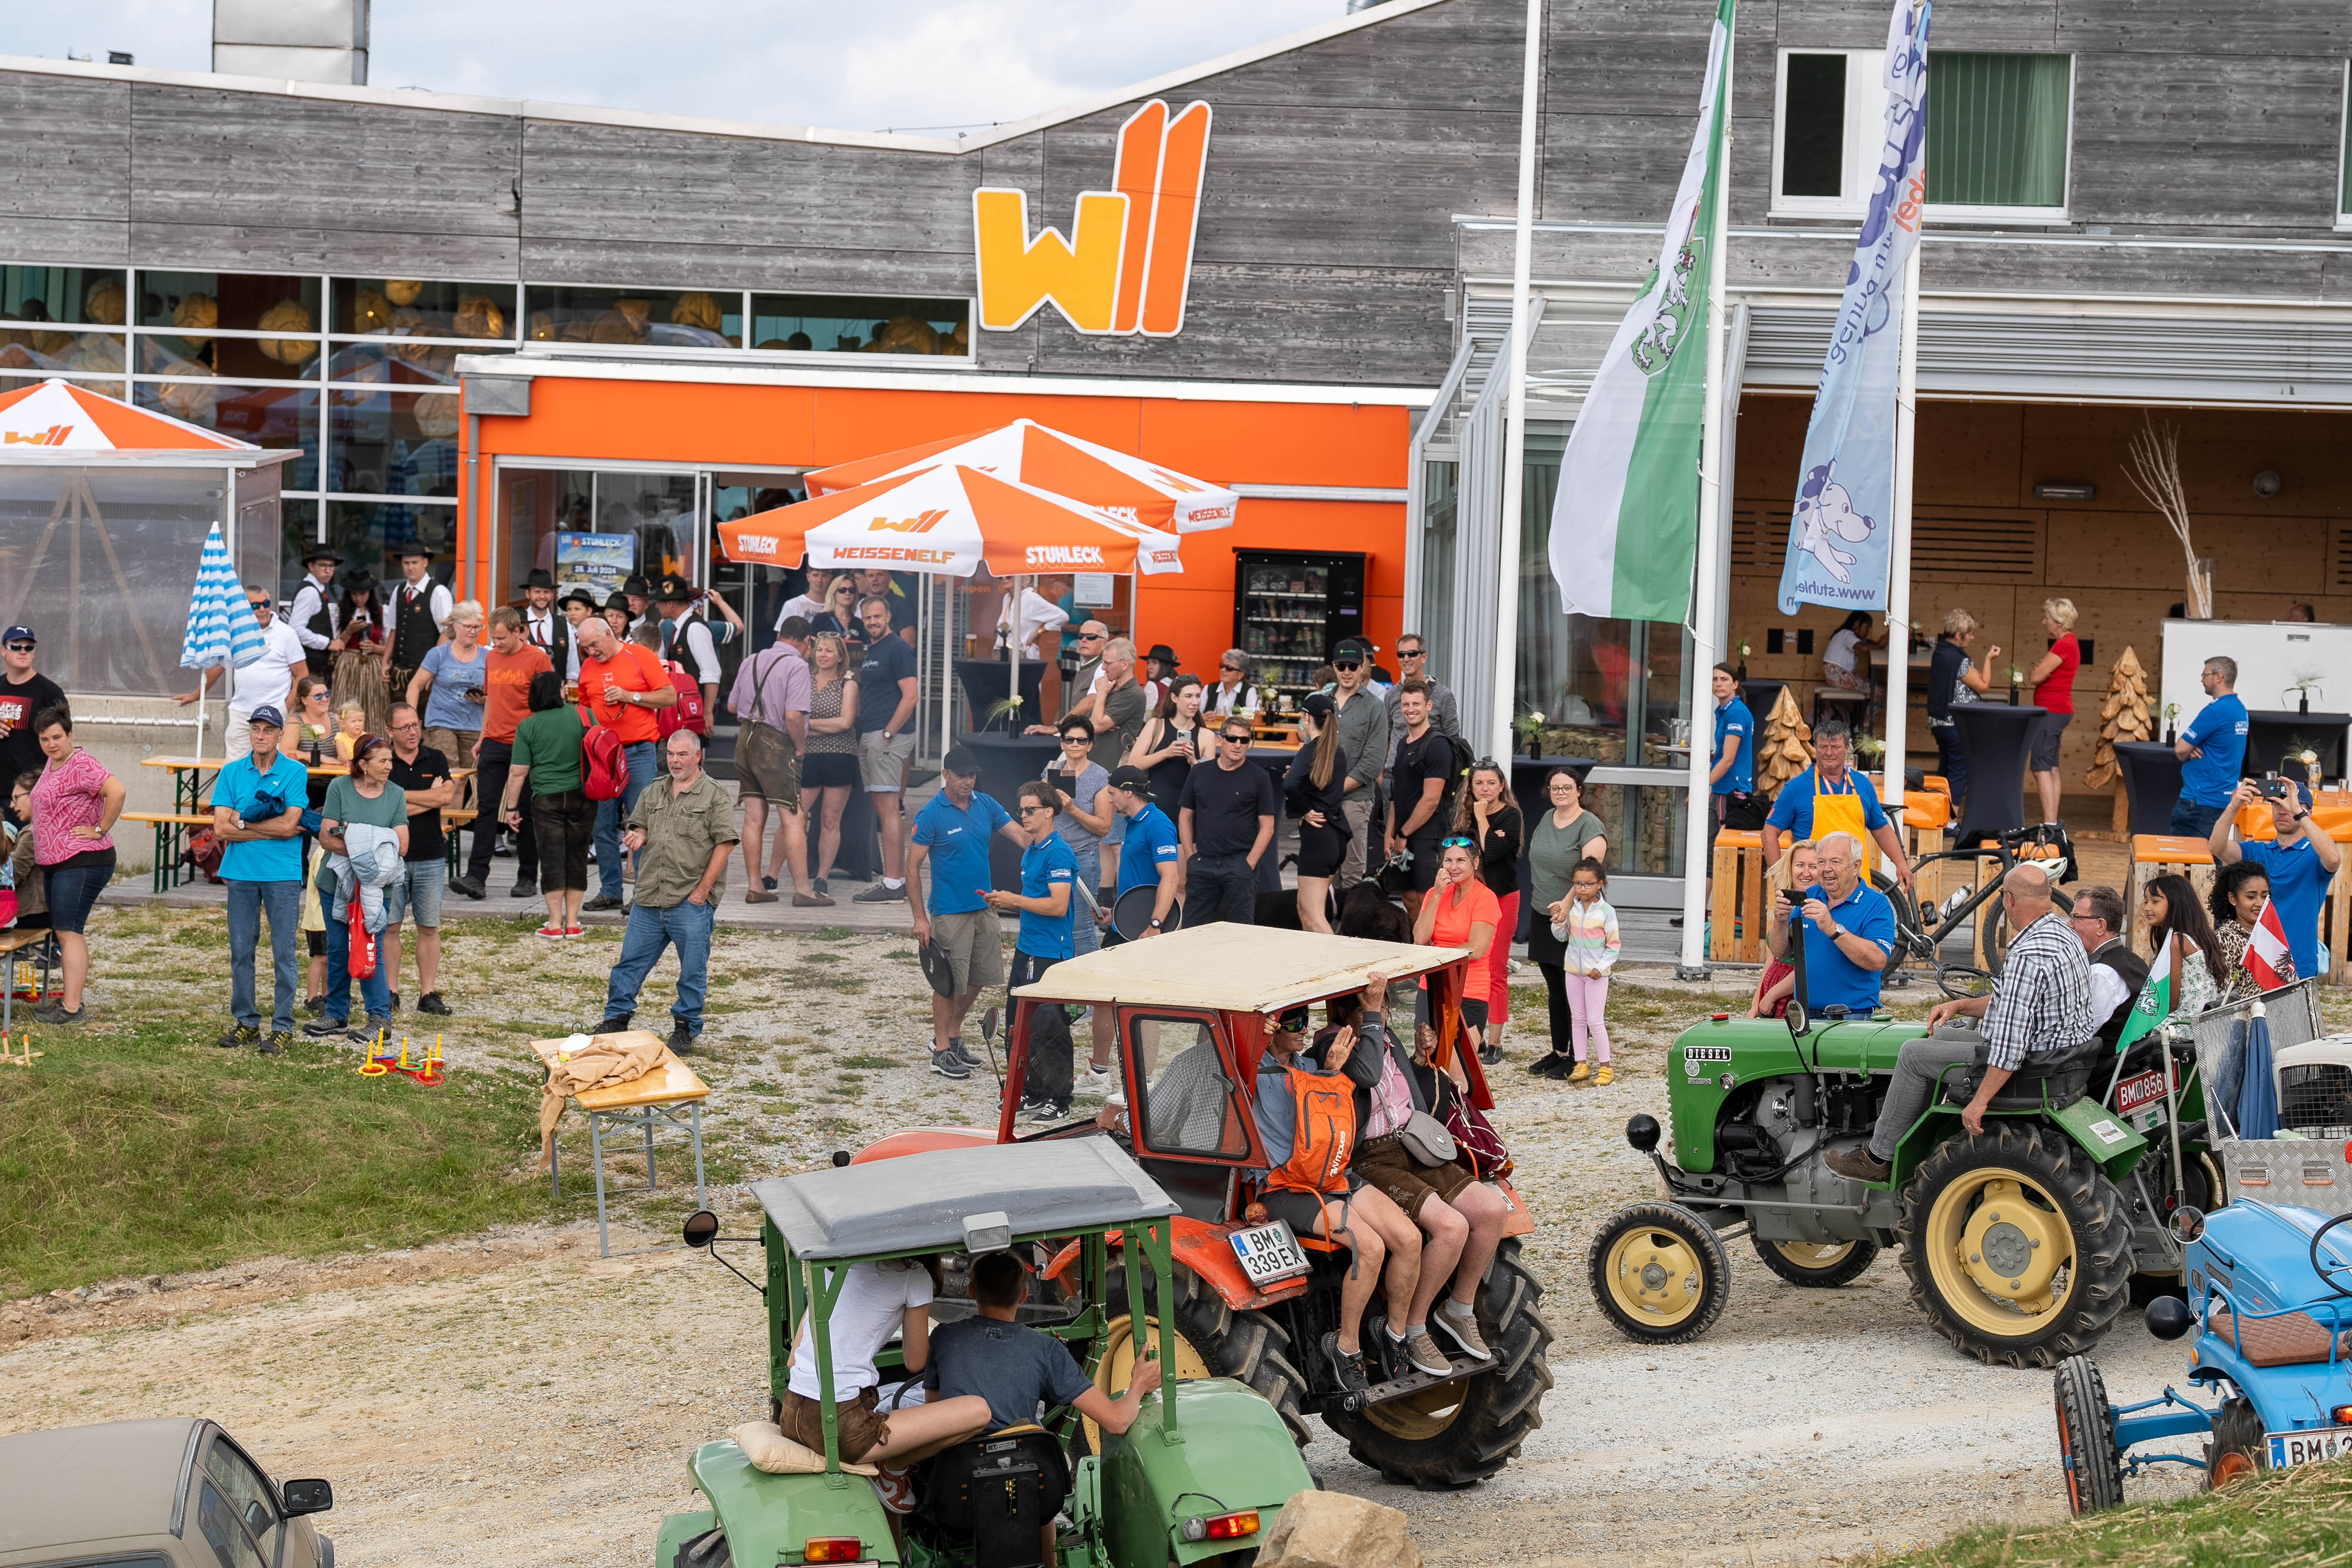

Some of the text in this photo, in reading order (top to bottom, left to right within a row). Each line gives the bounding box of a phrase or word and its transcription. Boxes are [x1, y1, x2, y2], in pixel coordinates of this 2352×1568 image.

[581, 537, 621, 548] STUHLECK
[737, 534, 779, 554] STUHLECK
[834, 547, 956, 564] WEISSENELF
[1025, 546, 1104, 566] STUHLECK
[586, 566, 599, 574] Juli
[1688, 1048, 1728, 1059] DIESEL
[2120, 1083, 2136, 1106] BM
[2144, 1072, 2163, 1097] 856
[1250, 1229, 1276, 1252] BM
[1248, 1252, 1281, 1275] 339
[2291, 1439, 2323, 1465] BM
